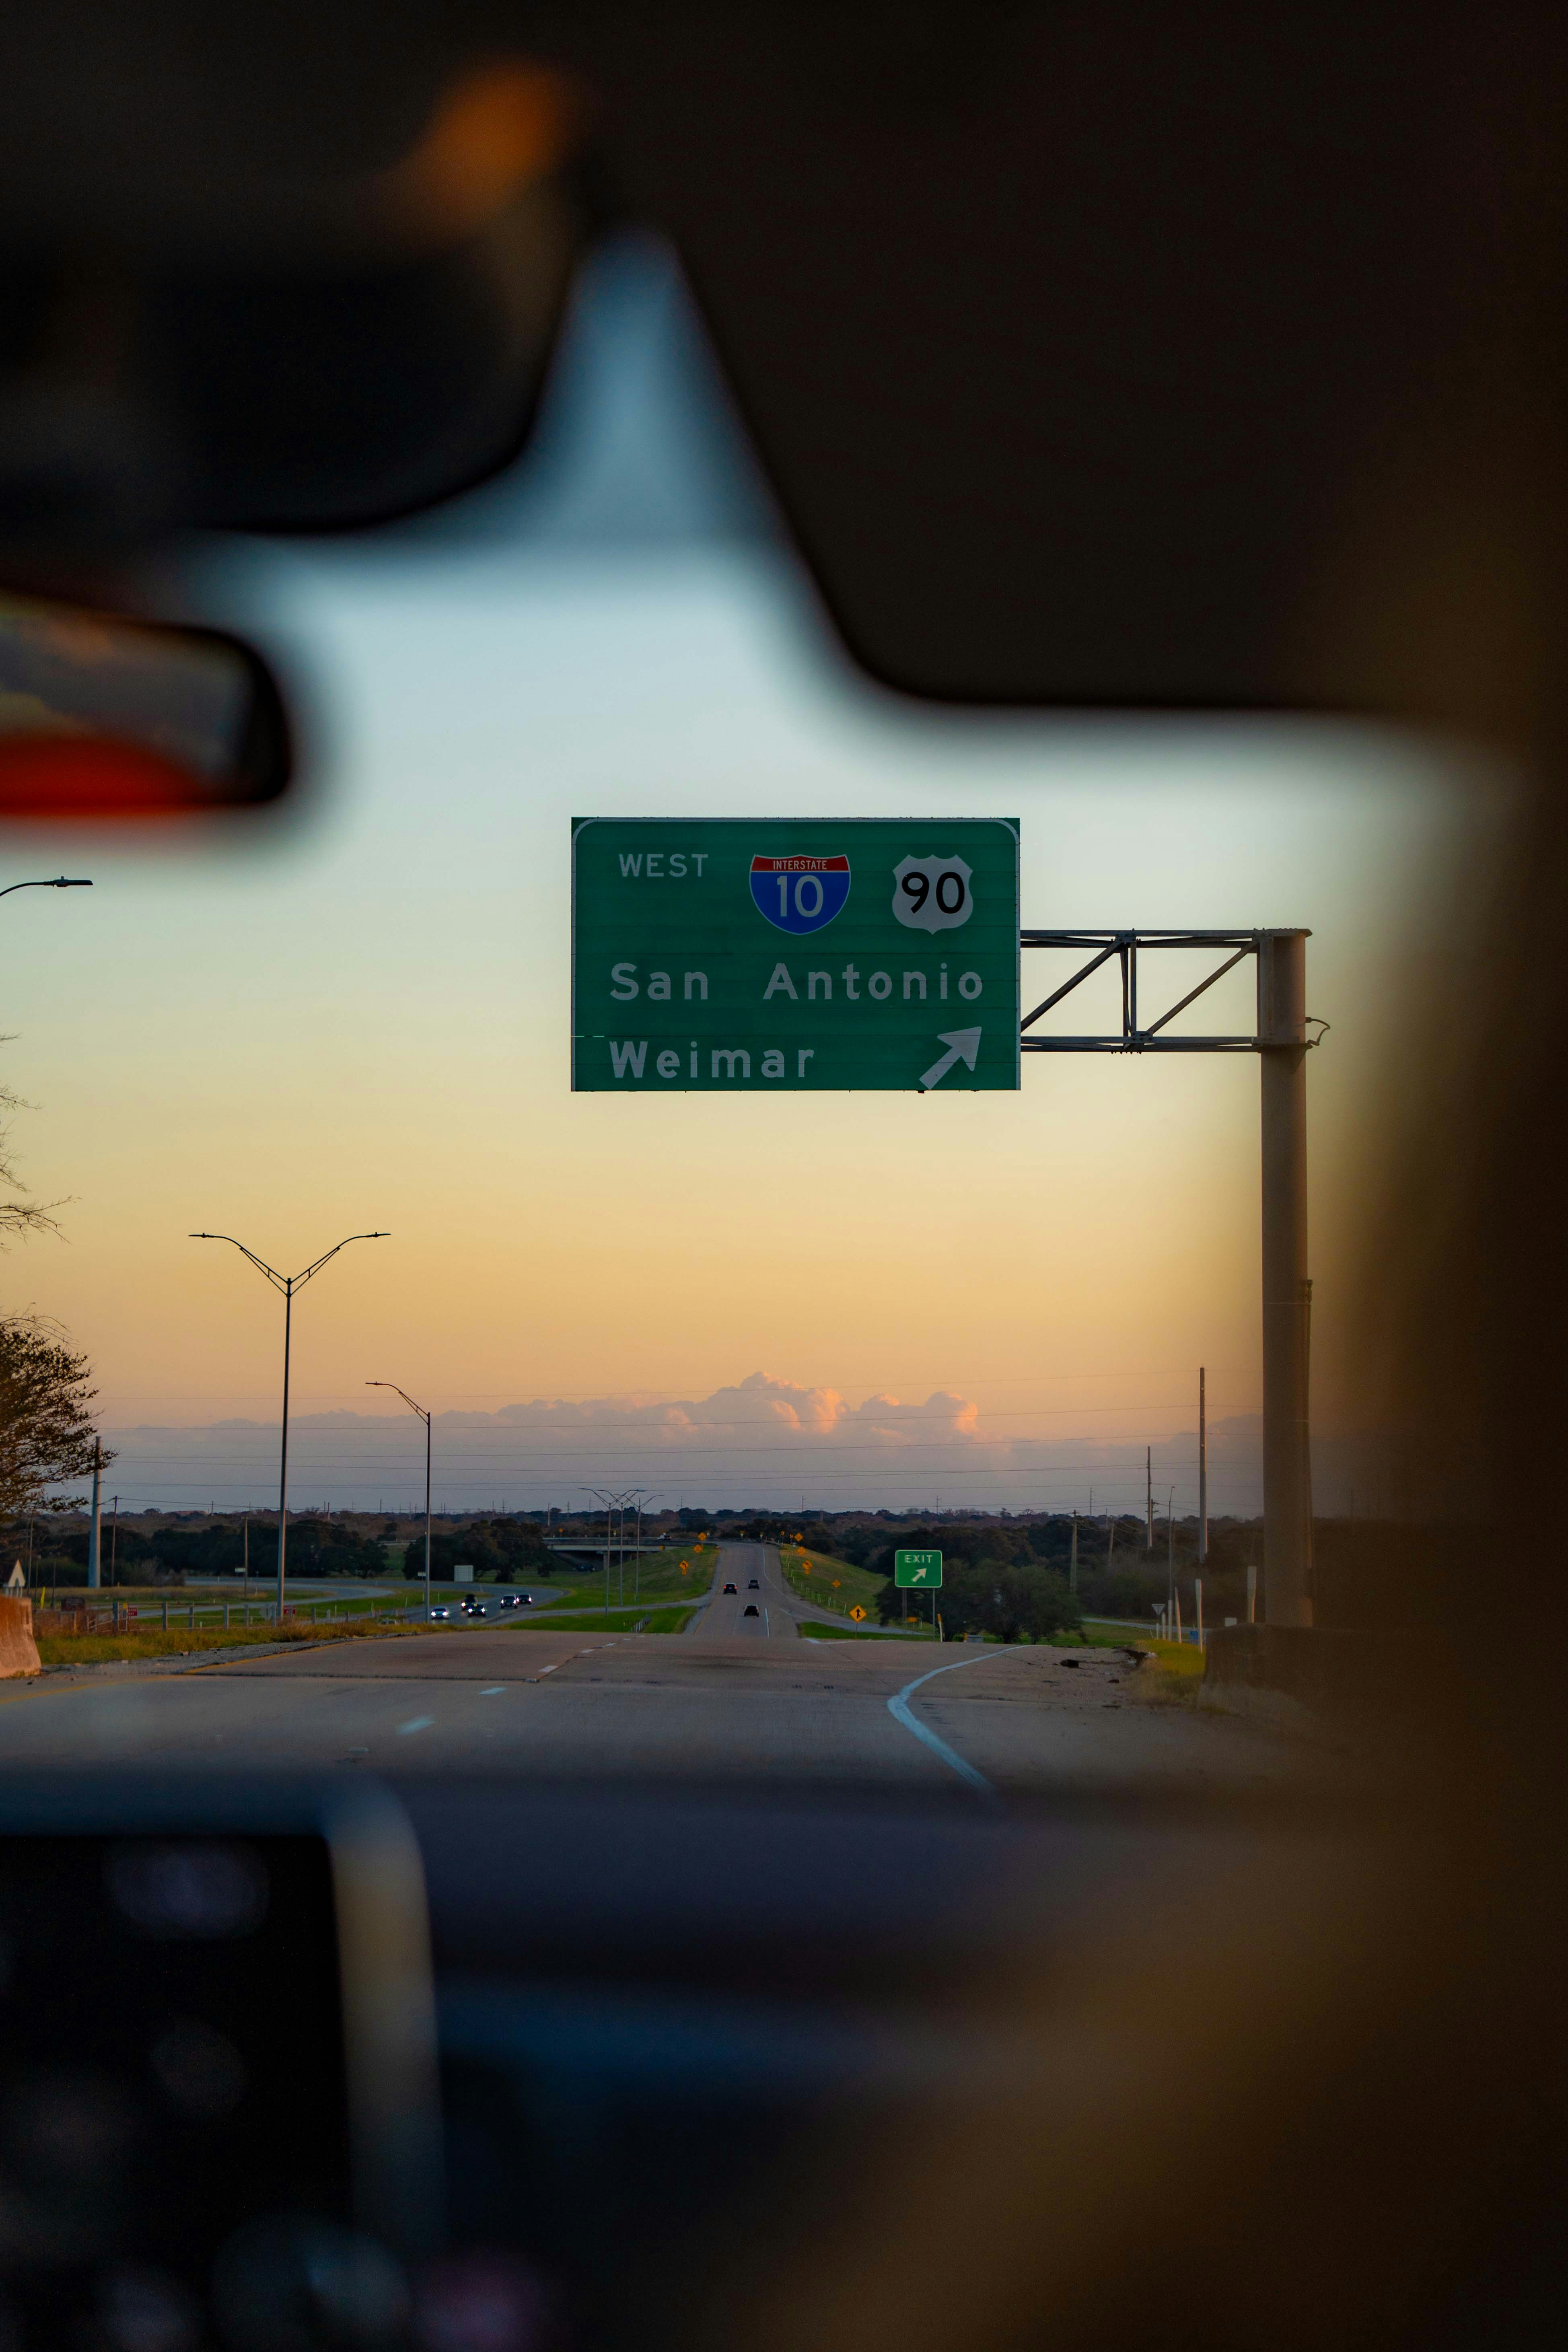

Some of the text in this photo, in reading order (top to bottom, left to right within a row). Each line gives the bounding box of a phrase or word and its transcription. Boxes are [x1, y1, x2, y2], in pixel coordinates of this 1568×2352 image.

[619, 854, 708, 877] WEST
[773, 860, 827, 870] INTERSTATE
[777, 875, 823, 917] 10
[901, 871, 965, 914] 90
[610, 963, 983, 1000] San Antonio
[610, 1041, 814, 1078] Weimar
[905, 1555, 932, 1563] EXIT
